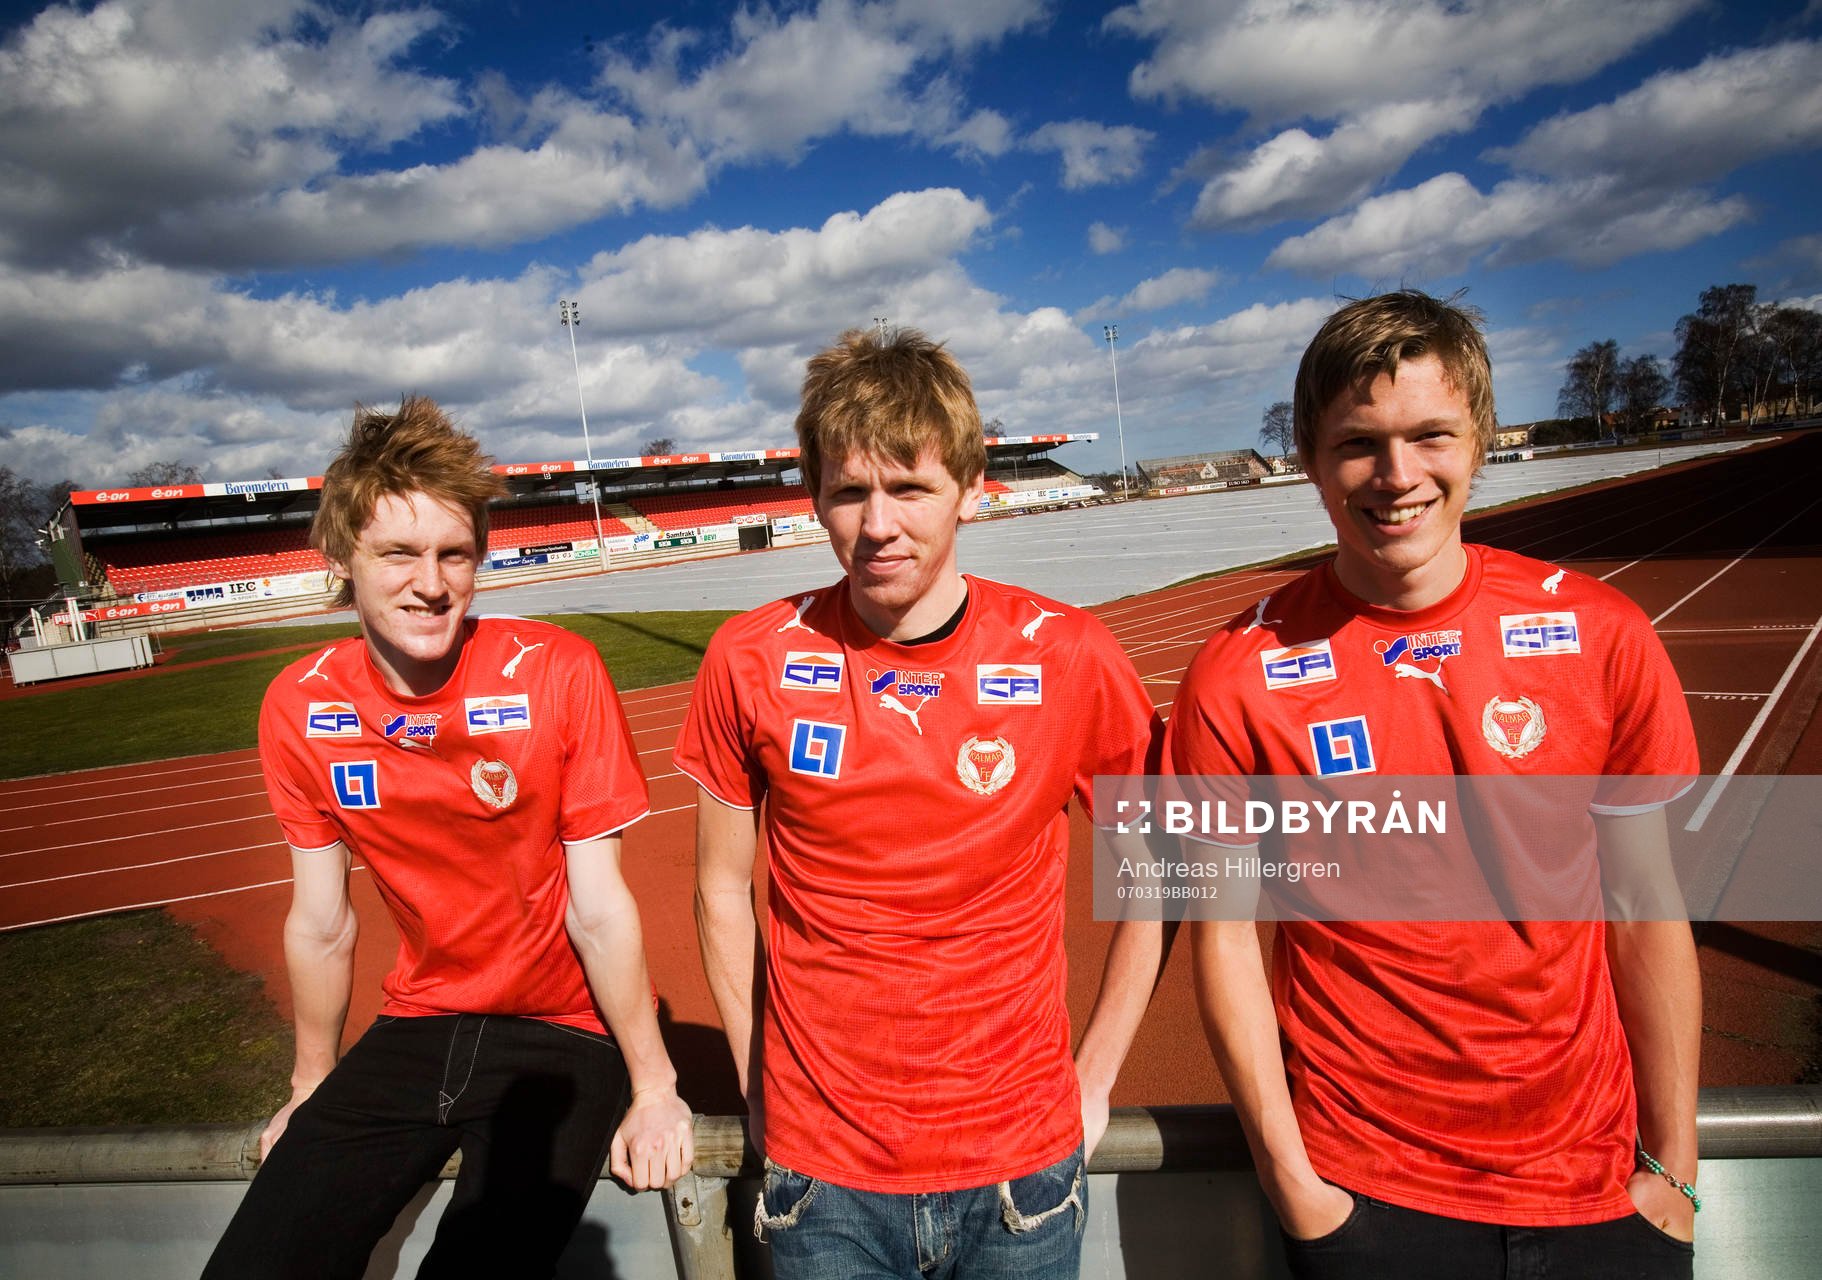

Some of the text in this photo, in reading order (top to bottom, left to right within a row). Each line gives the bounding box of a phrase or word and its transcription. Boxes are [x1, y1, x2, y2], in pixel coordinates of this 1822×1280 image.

[225, 481, 289, 494] Barometern
[229, 581, 256, 593] IEC
[55, 612, 87, 625] PUA
[1408, 631, 1460, 649] INTER
[1412, 643, 1460, 661] SPORT
[898, 671, 940, 685] INTER
[898, 683, 941, 697] SPORT
[406, 714, 438, 726] INTER
[1493, 711, 1530, 723] KALMAR
[406, 725, 436, 736] SPORT
[969, 750, 1003, 763] KALMAR
